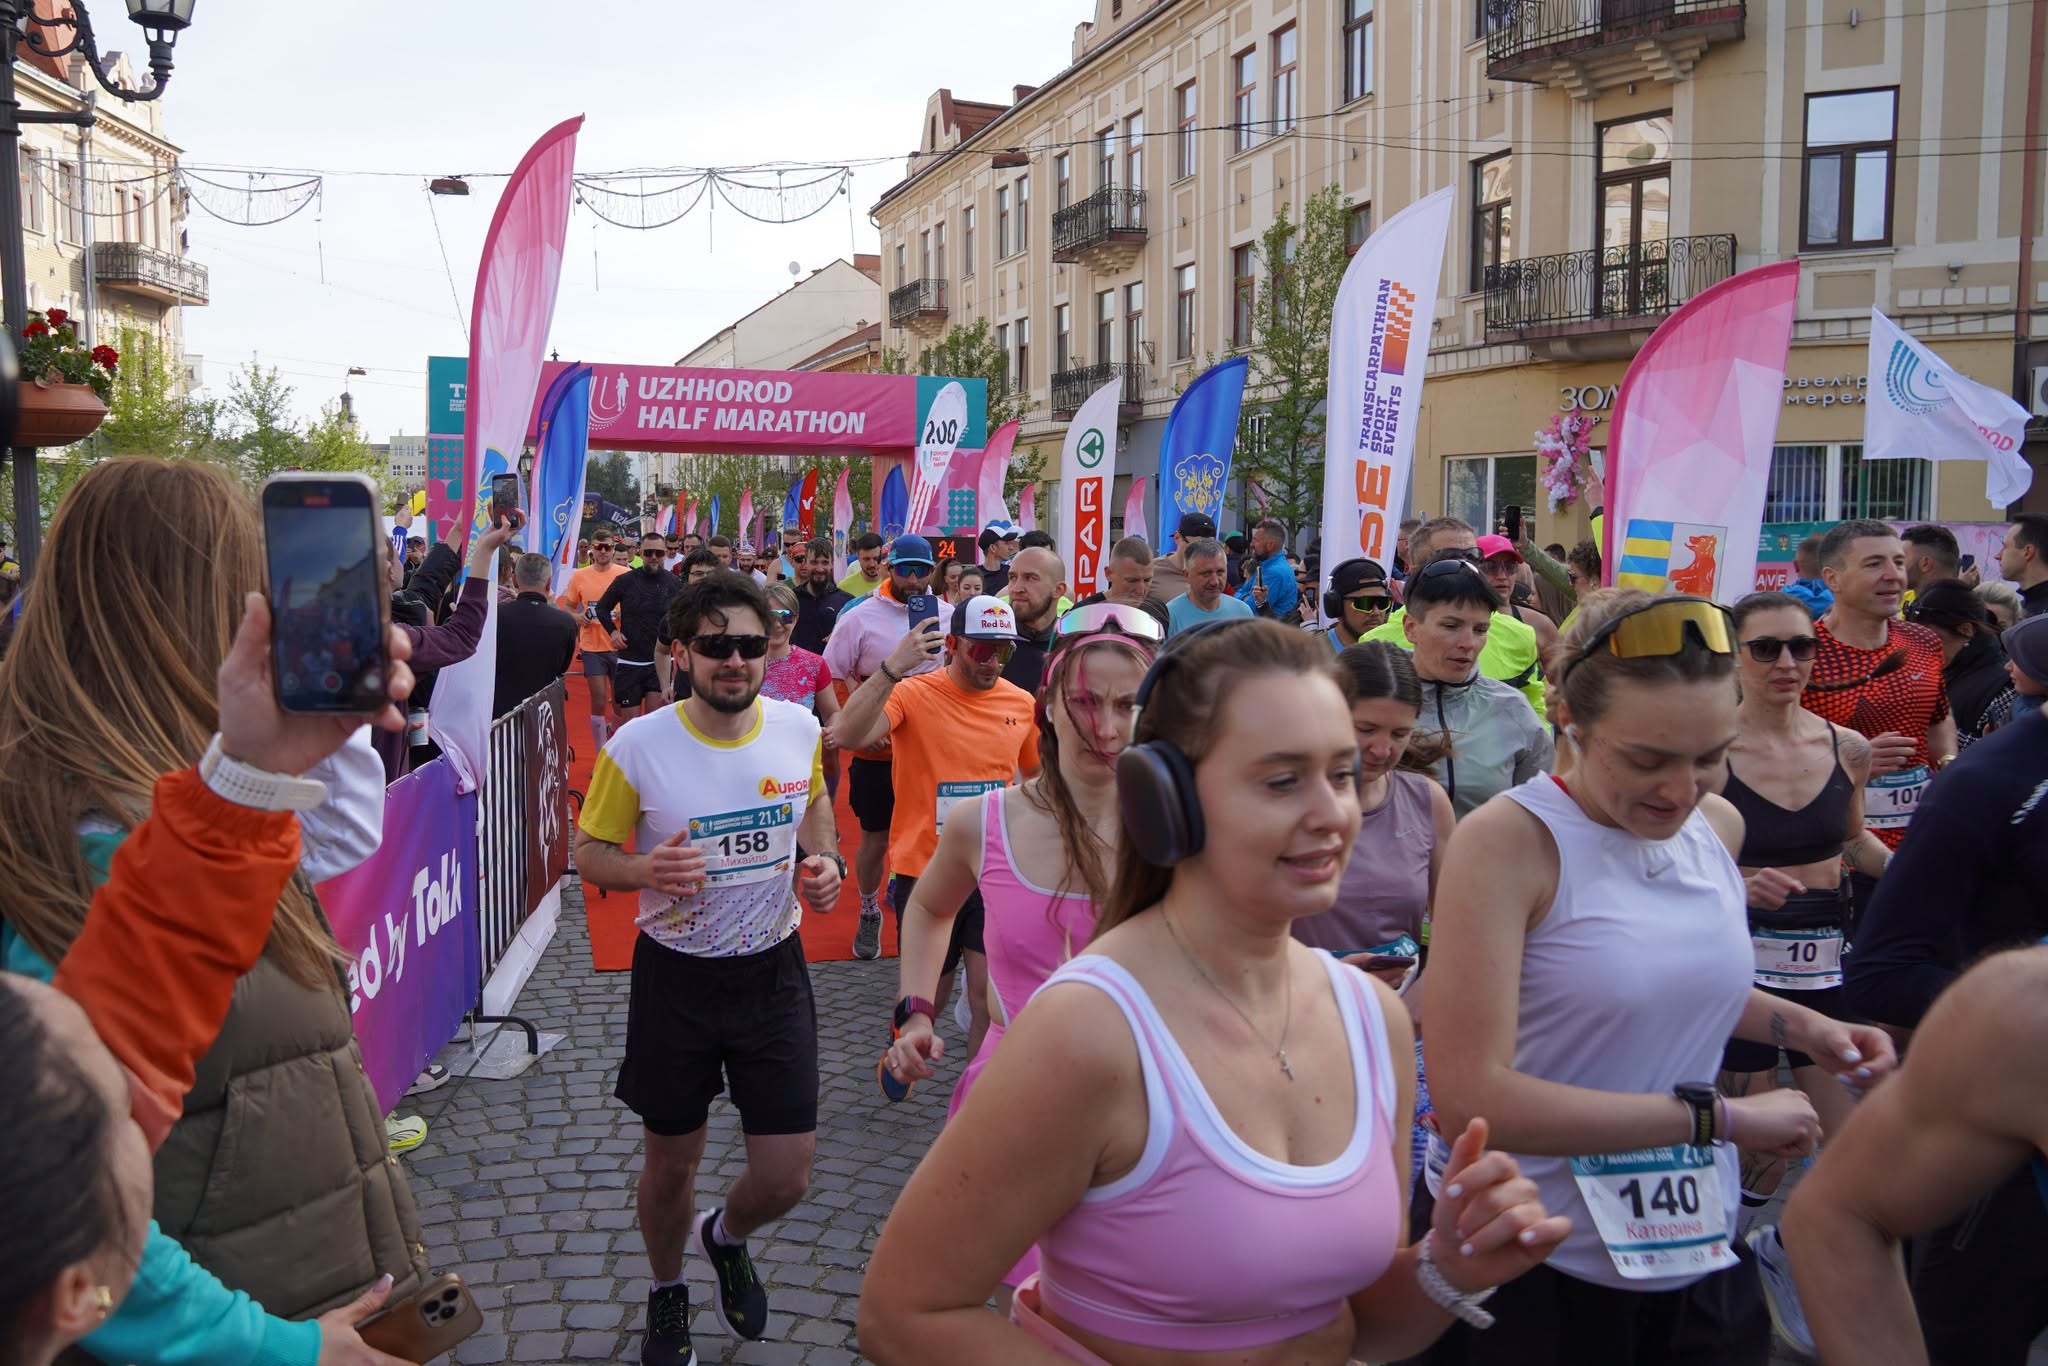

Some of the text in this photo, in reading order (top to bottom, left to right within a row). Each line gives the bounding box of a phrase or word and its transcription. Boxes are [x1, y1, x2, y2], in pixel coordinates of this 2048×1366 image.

[1359, 278, 1391, 450] TRANSCARPATHIAN
[449, 383, 467, 398] T
[638, 376, 793, 404] UZHHOROD
[637, 405, 866, 434] HALF MARATHON
[1371, 395, 1388, 453] SPORT
[1383, 385, 1402, 456] EVENTS
[981, 619, 1012, 629] Red Bull
[762, 779, 811, 796] AUROR
[718, 831, 770, 856] 158
[720, 854, 768, 868] Михайло
[384, 911, 409, 984] by
[1787, 942, 1818, 962] 10
[1619, 1175, 1699, 1218] 140
[1624, 1221, 1704, 1241] Катерина
